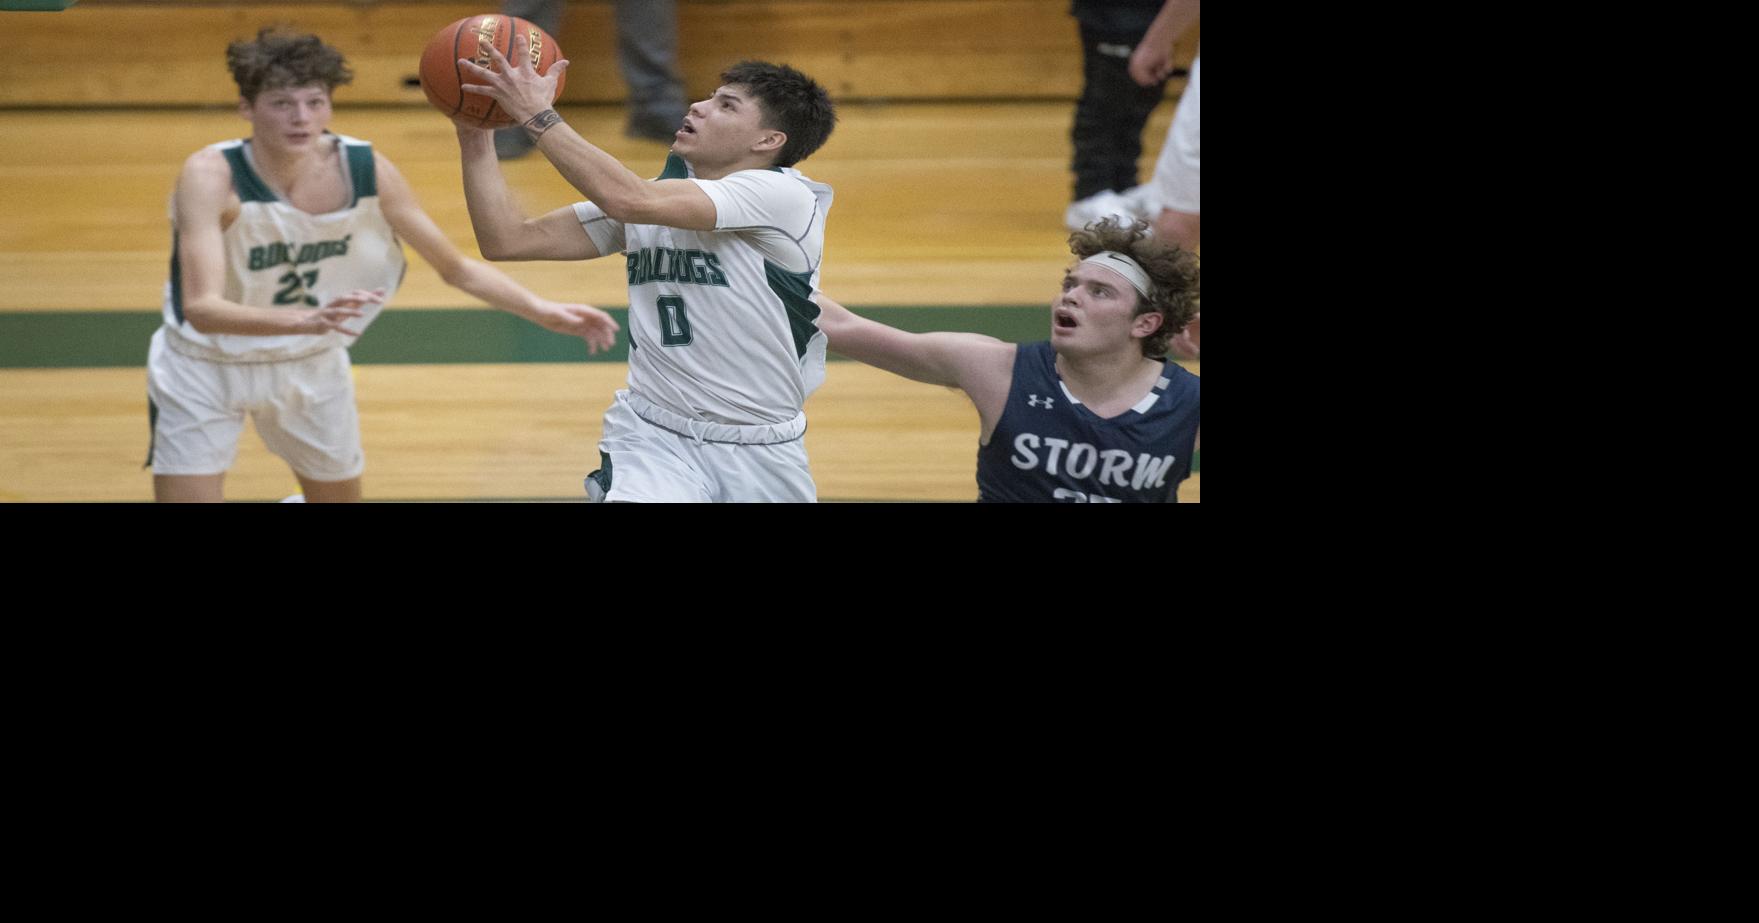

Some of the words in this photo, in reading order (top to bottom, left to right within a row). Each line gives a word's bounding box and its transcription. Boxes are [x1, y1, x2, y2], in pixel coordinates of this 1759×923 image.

[528, 28, 543, 70] LITE
[627, 246, 730, 287] BULLDOGS
[656, 294, 694, 347] 0
[1010, 432, 1175, 491] STORM
